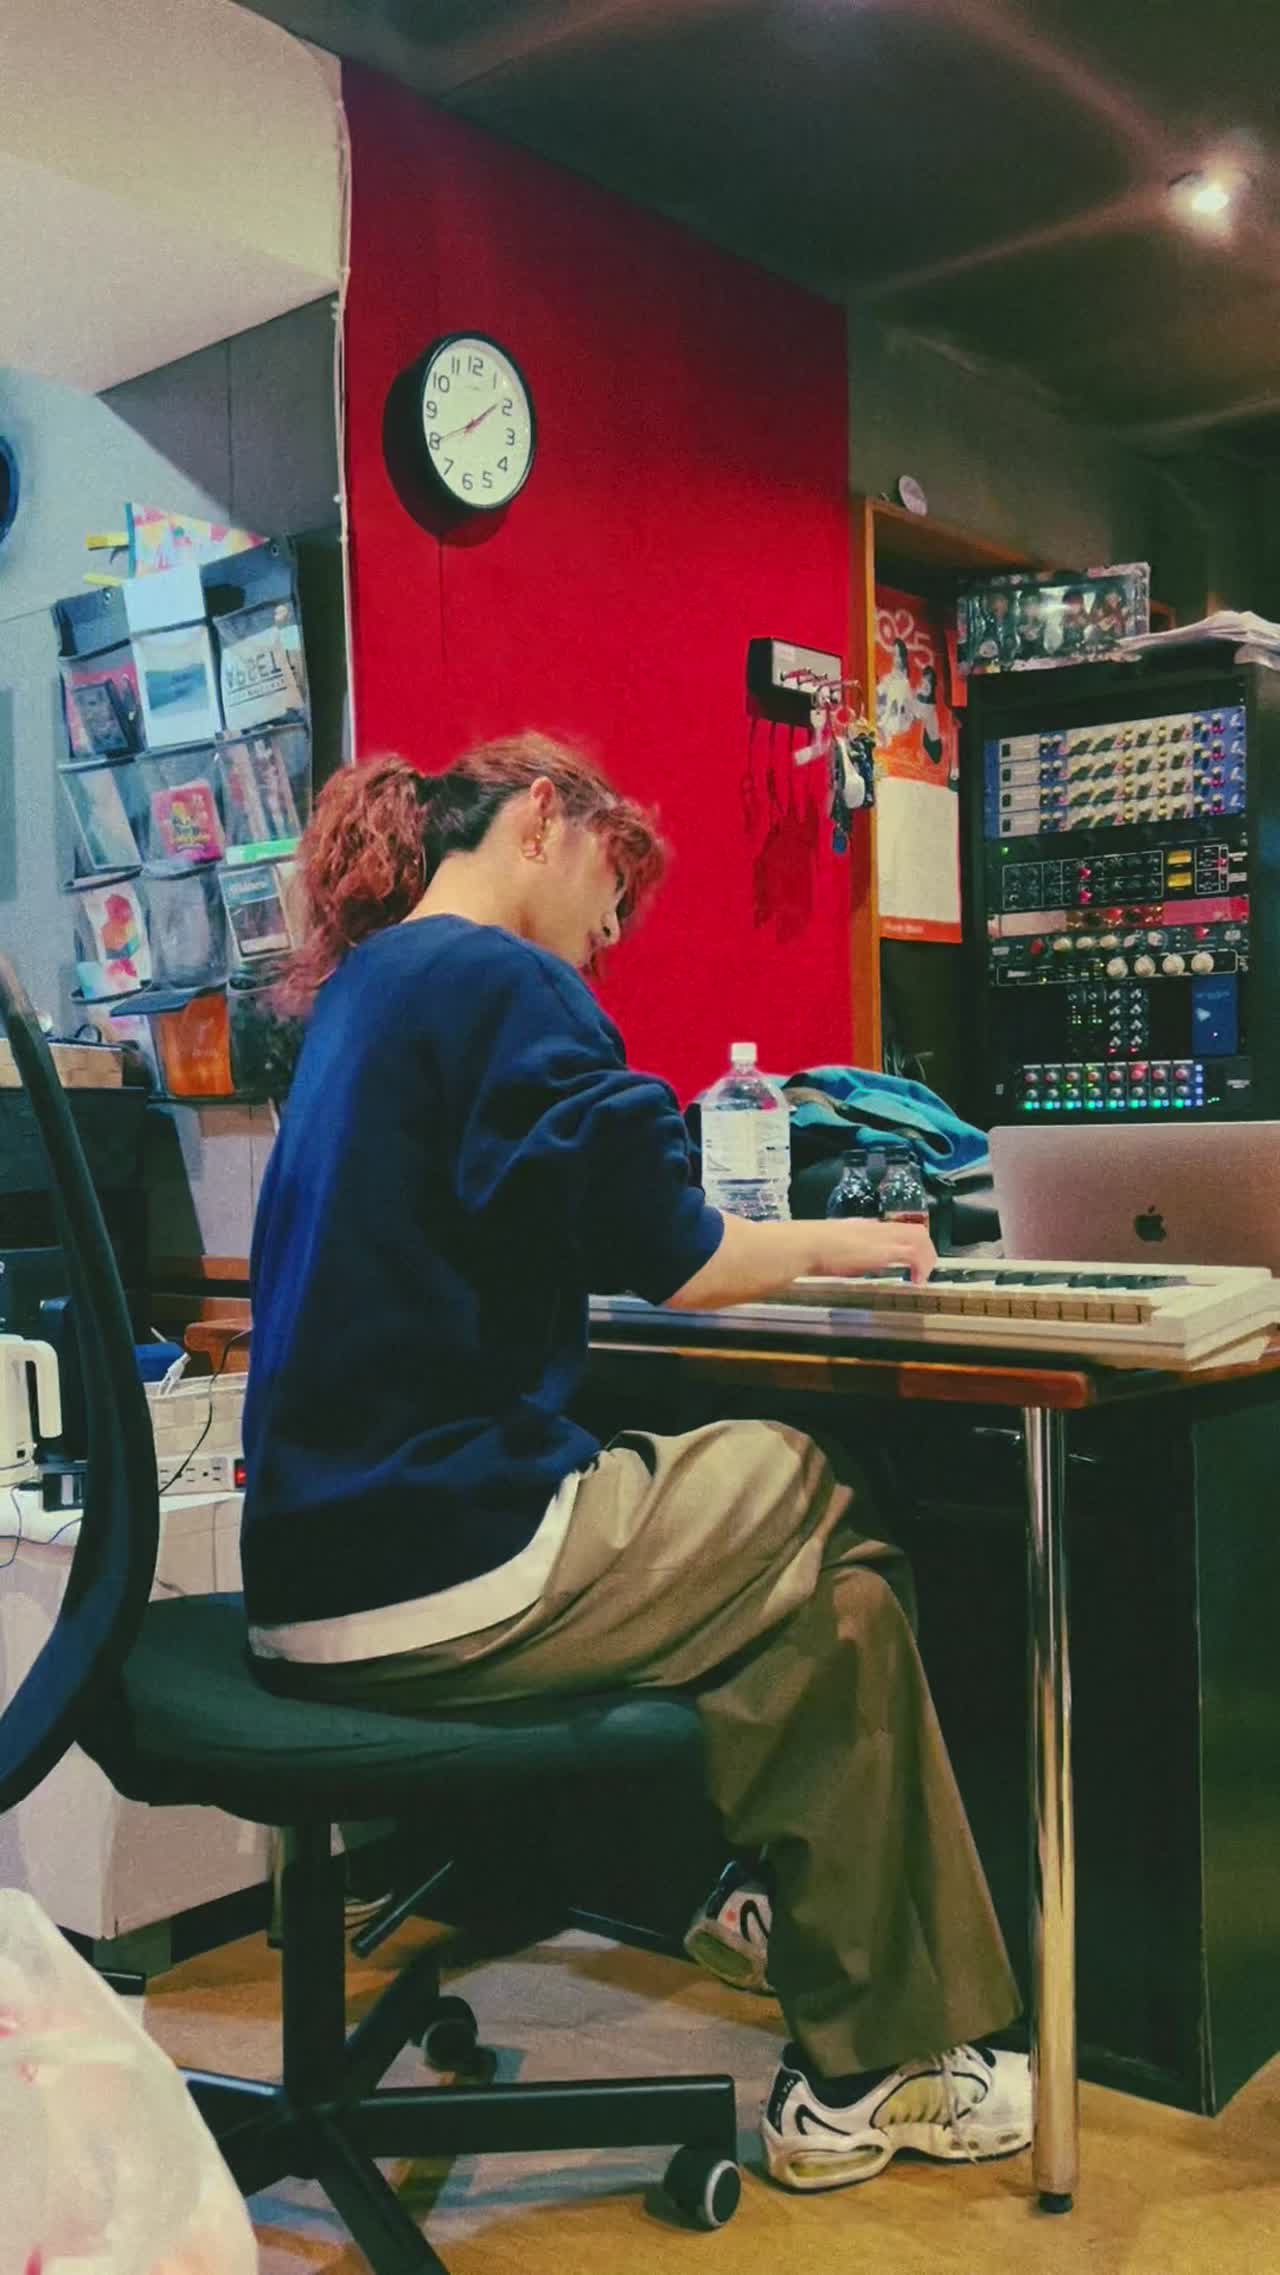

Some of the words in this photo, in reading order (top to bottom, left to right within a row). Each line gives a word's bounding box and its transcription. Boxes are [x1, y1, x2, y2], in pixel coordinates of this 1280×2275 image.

[451, 356, 461, 376] 11
[468, 355, 484, 377] 12
[432, 371, 450, 393] 10
[492, 370, 498, 389] 1
[426, 401, 438, 420] 9
[502, 399, 513, 416] 2
[428, 432, 441, 451] 8
[505, 428, 516, 446] 3
[444, 457, 455, 476] 7
[497, 456, 508, 472] 4
[461, 473, 473, 491] 6
[482, 471, 493, 489] 5
